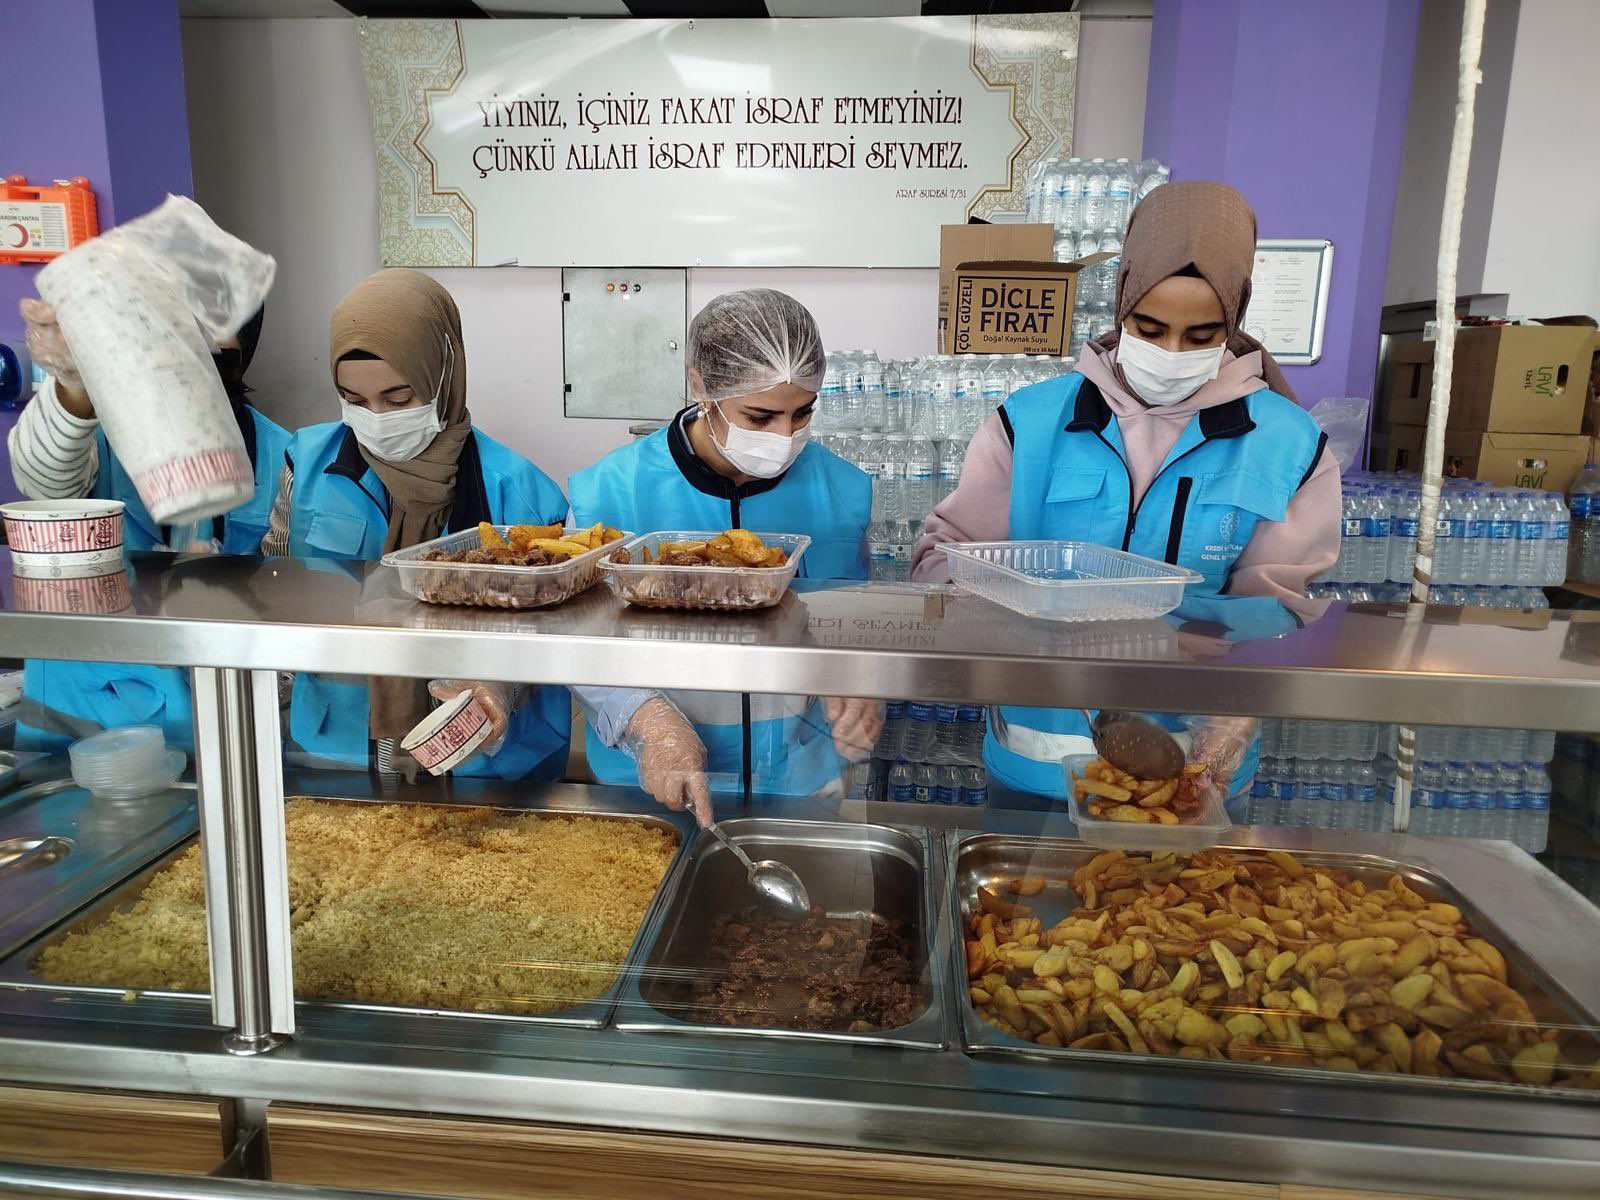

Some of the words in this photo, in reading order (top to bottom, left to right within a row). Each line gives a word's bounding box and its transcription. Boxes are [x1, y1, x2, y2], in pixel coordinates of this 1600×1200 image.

[477, 93, 567, 129] YİYİNİZ,
[578, 92, 650, 133] İÇİNİZ
[661, 97, 735, 124] FAKAT
[745, 90, 823, 124] İSRAF
[834, 89, 962, 125] ETMEYİNİZ!
[473, 138, 555, 179] ÇÜNKÜ
[565, 143, 638, 171] ALLAH
[648, 136, 724, 170] İSRAF
[736, 135, 856, 170] EDENLERİ
[866, 142, 968, 170] SEVMEZ.
[950, 189, 967, 199] 7/31
[959, 280, 973, 323] GÜZELİ
[981, 283, 1056, 310] DİCLE
[980, 311, 1055, 333] FIRAT
[958, 327, 971, 350] ÇÖL
[983, 335, 1004, 343] Doğal
[1005, 336, 1029, 344] Kaynak
[1031, 336, 1048, 344] Suyu
